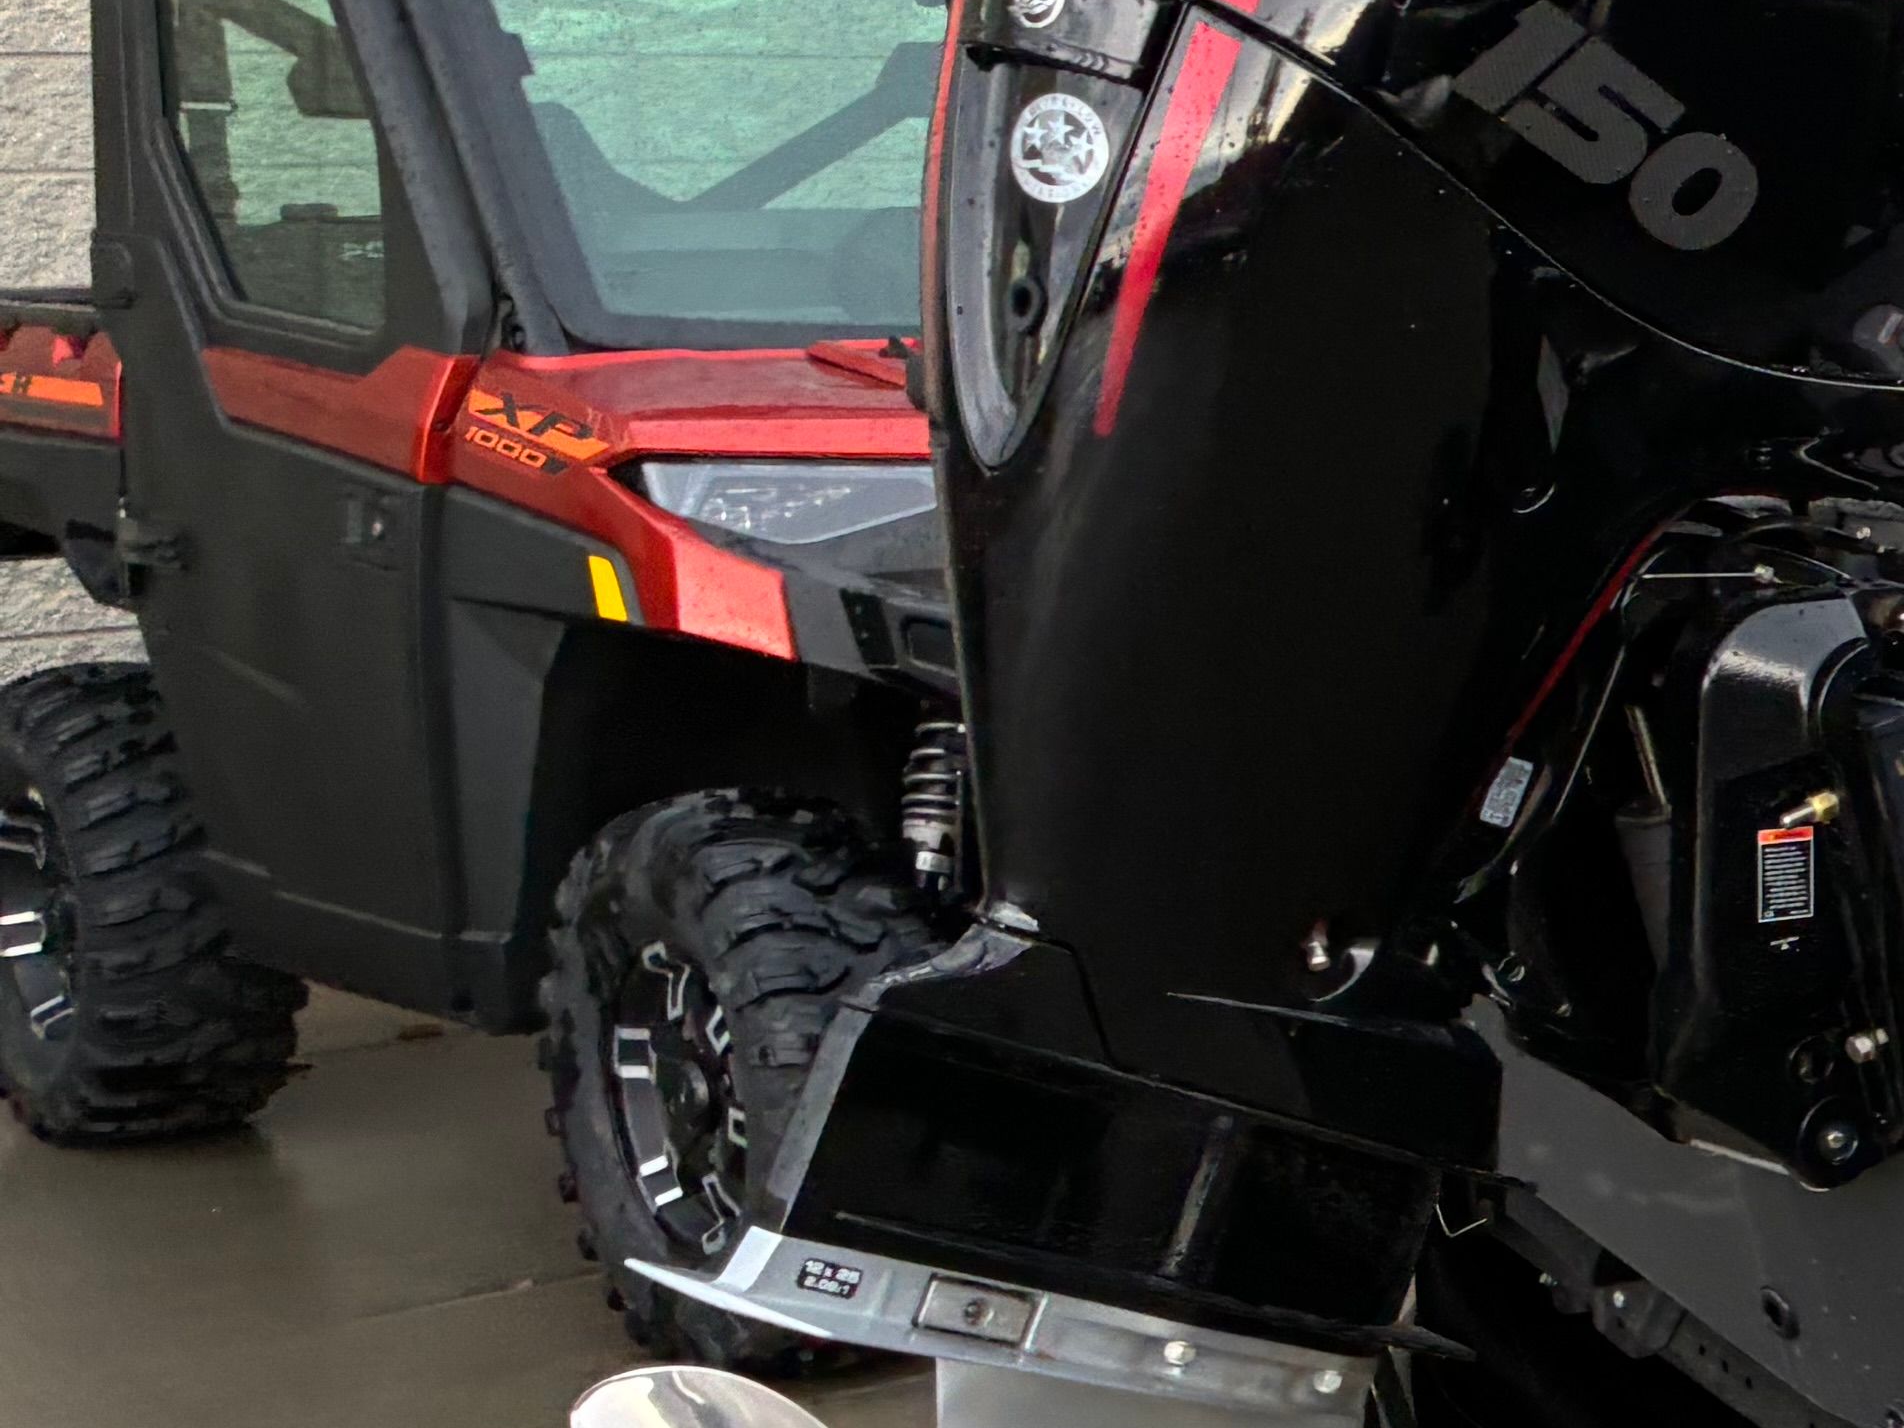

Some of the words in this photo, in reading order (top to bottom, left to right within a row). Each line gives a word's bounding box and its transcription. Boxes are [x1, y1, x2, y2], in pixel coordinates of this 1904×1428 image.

[1451, 0, 1759, 252] 150
[475, 392, 593, 439] XP
[465, 426, 548, 468] 1000
